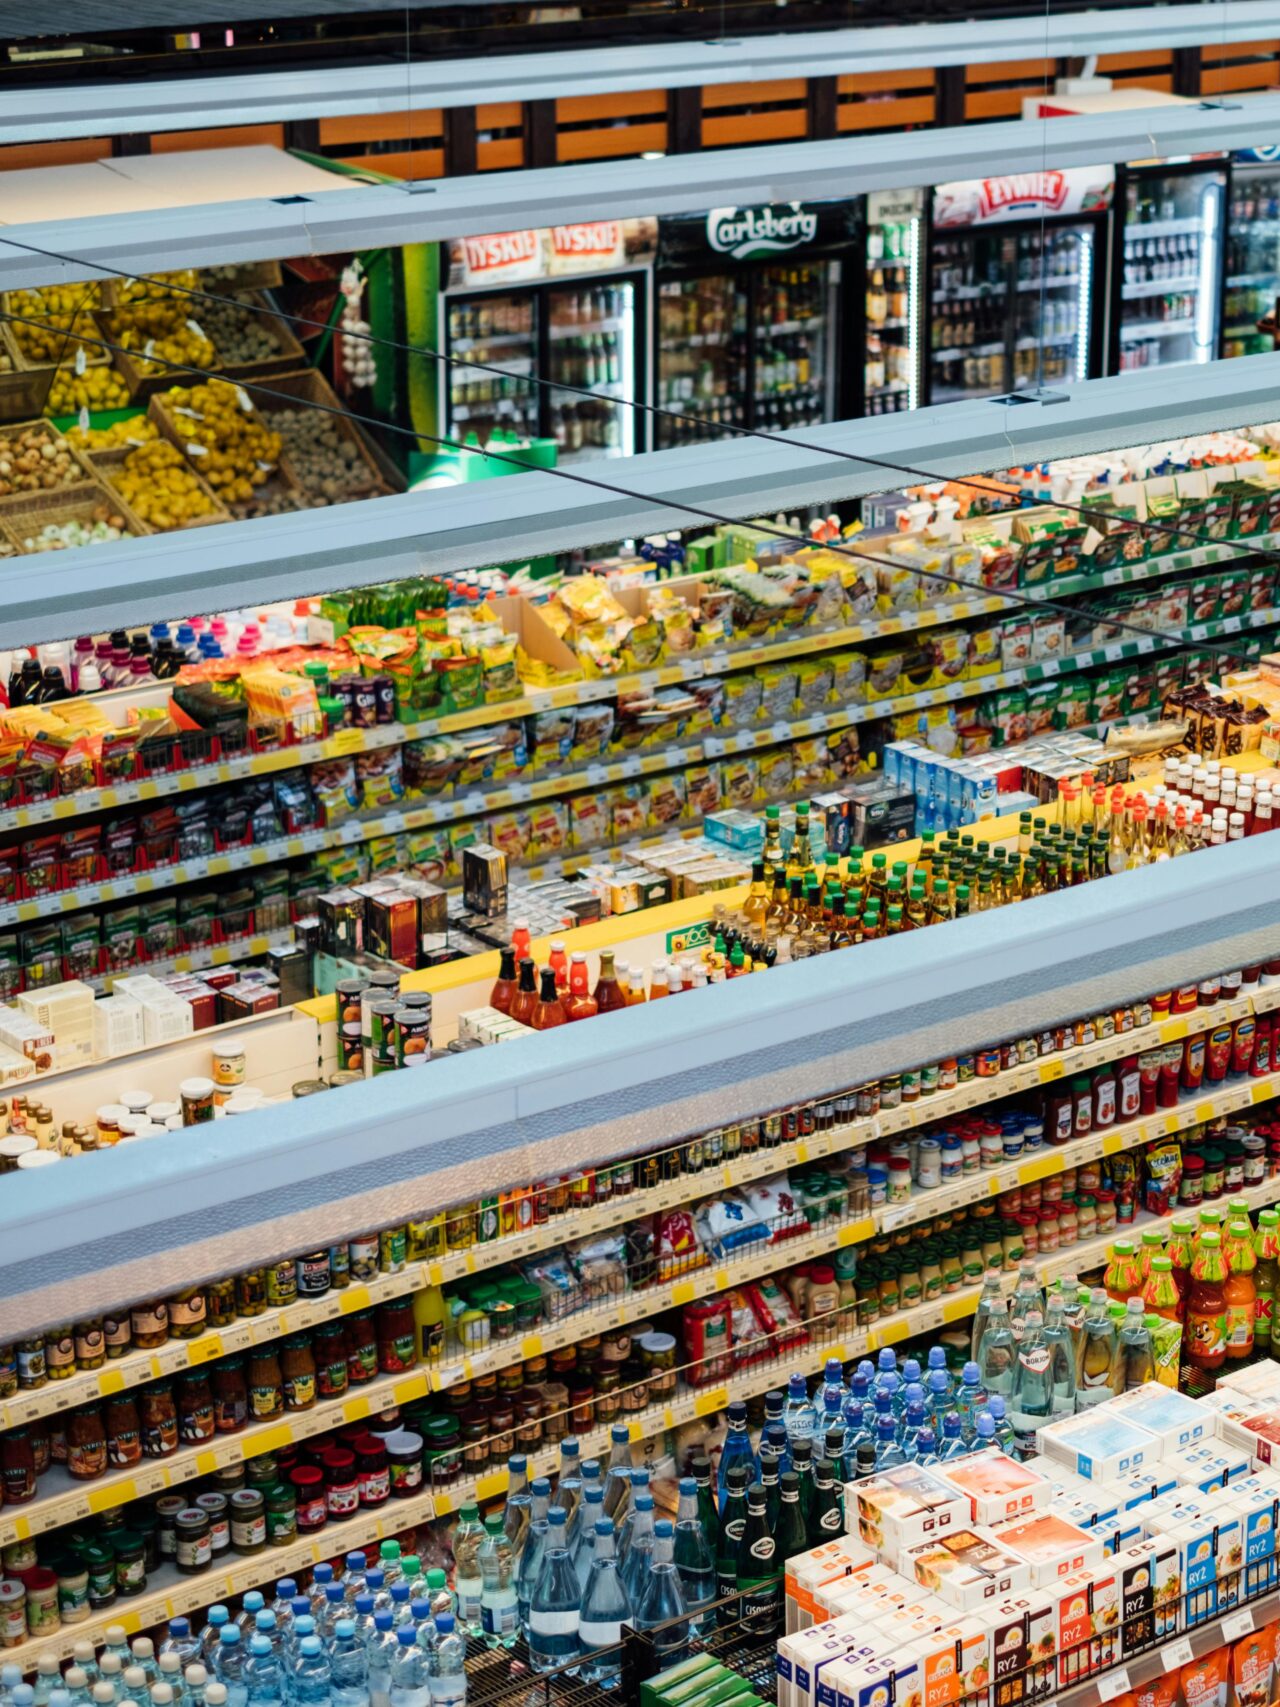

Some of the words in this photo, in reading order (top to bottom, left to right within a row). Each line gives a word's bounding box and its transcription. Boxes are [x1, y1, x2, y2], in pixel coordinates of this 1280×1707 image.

[707, 201, 817, 252] Carlsberg
[1126, 1594, 1145, 1614] RYŻ
[1063, 1624, 1081, 1643] RYŻ
[997, 1654, 1018, 1674] RYŻ
[929, 1682, 949, 1701] RYŻ
